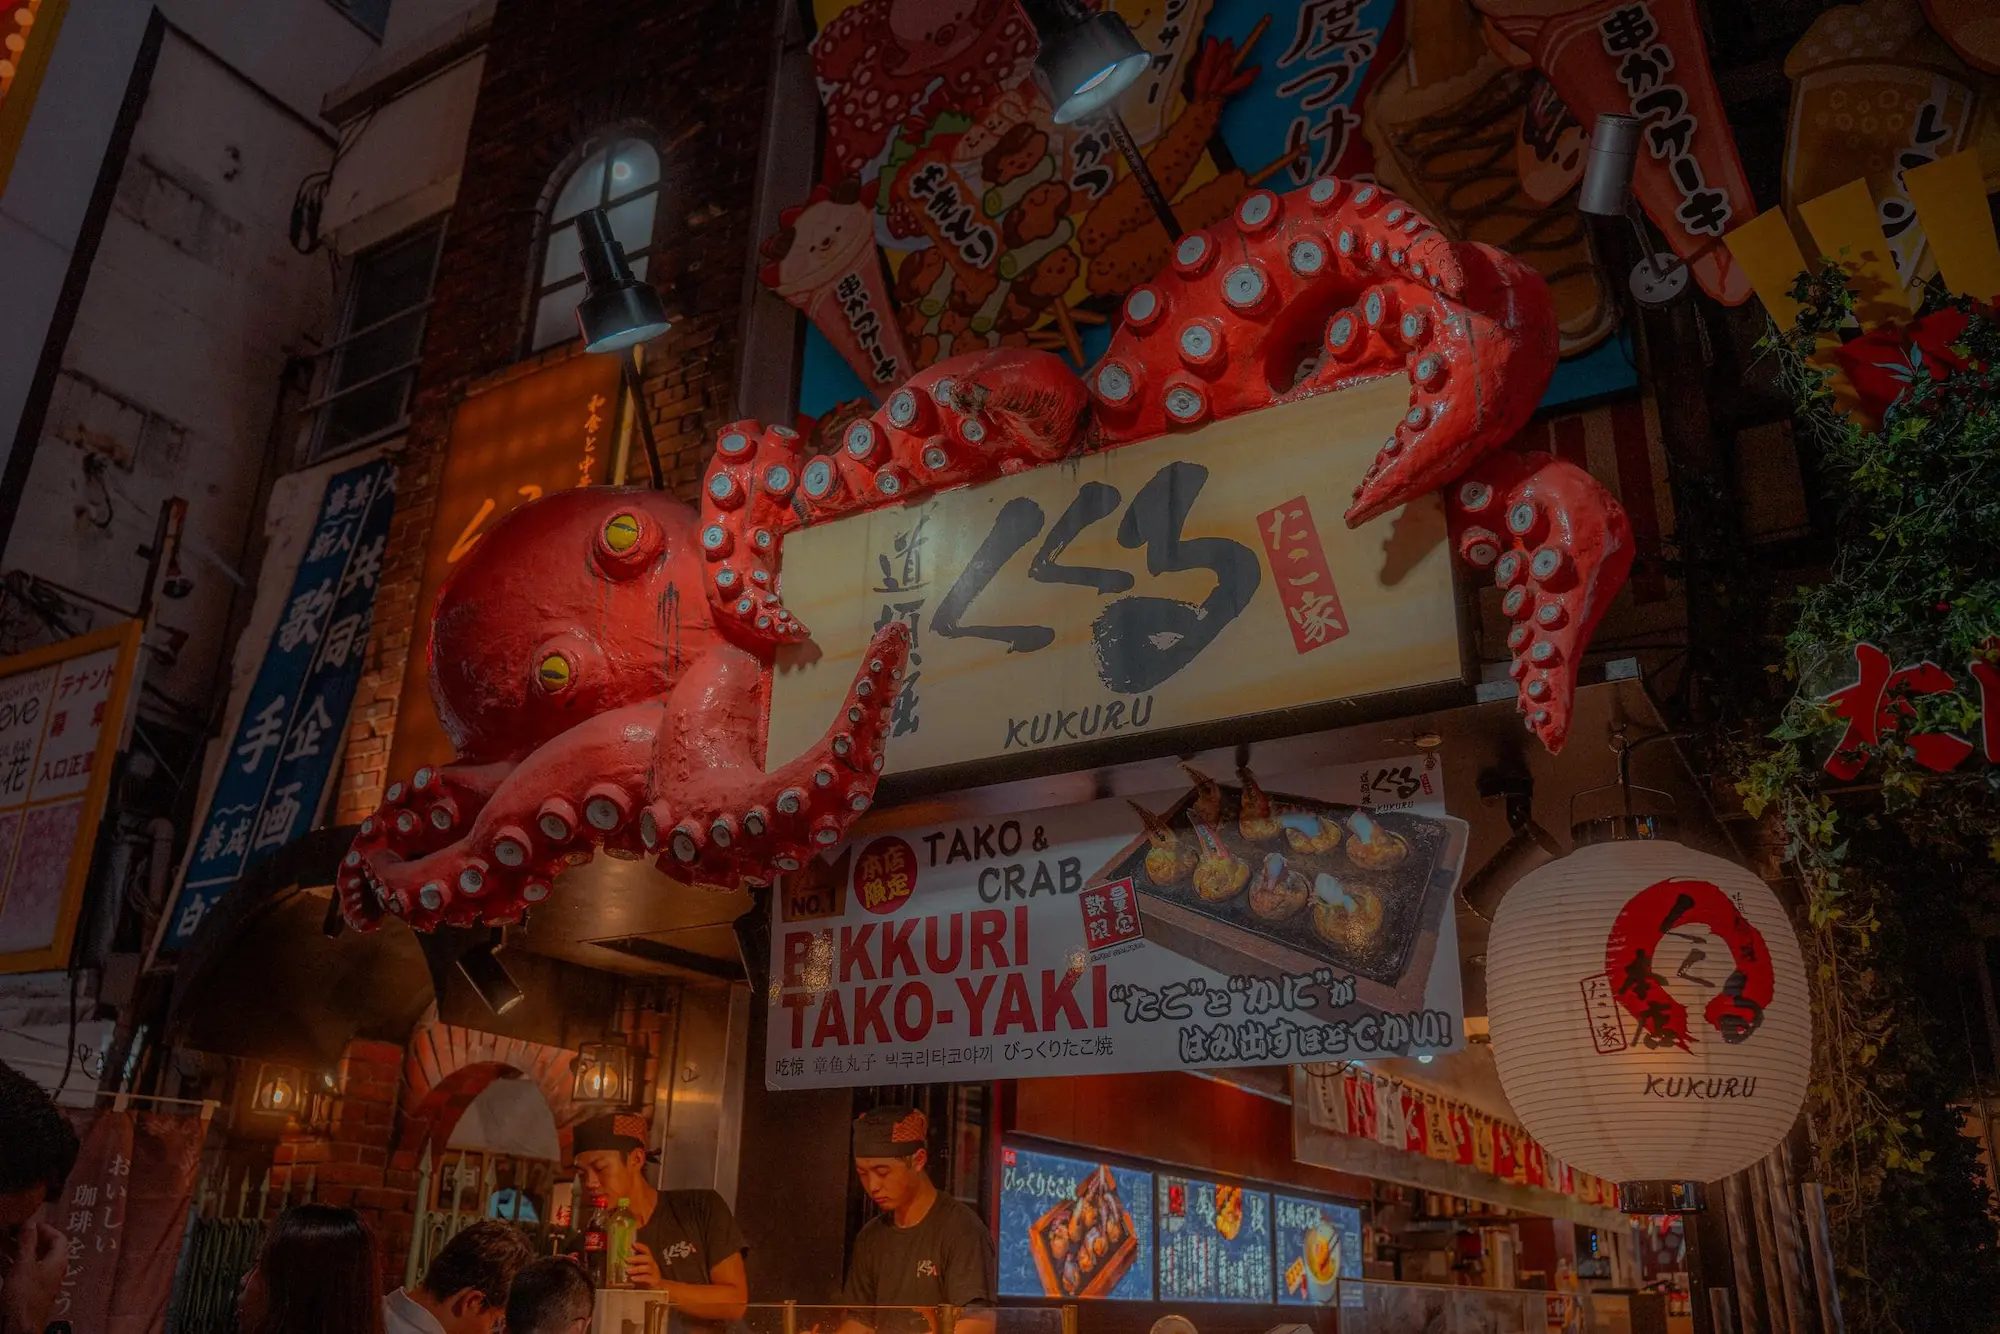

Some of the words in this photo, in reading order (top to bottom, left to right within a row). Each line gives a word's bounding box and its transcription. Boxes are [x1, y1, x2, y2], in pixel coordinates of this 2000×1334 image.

[1603, 5, 1730, 234] 串かつケーキ
[911, 163, 999, 270] やきとり
[837, 273, 900, 382] 串かつケーキ
[930, 461, 1261, 694] くくる
[1266, 505, 1346, 648] たこ家
[59, 664, 114, 699] テナント
[1003, 695, 1153, 749] KUKURU
[922, 820, 1022, 868] TAKO
[1032, 825, 1050, 852] &
[978, 856, 1083, 903] CRAB
[781, 965, 1108, 1049] TAKO-YAKI
[1004, 1036, 1114, 1061] びっくりたこ焼
[1643, 1074, 1757, 1099] KUKURU
[96, 1153, 132, 1253] おいしい
[54, 1183, 98, 1325] 珈琲をどう
